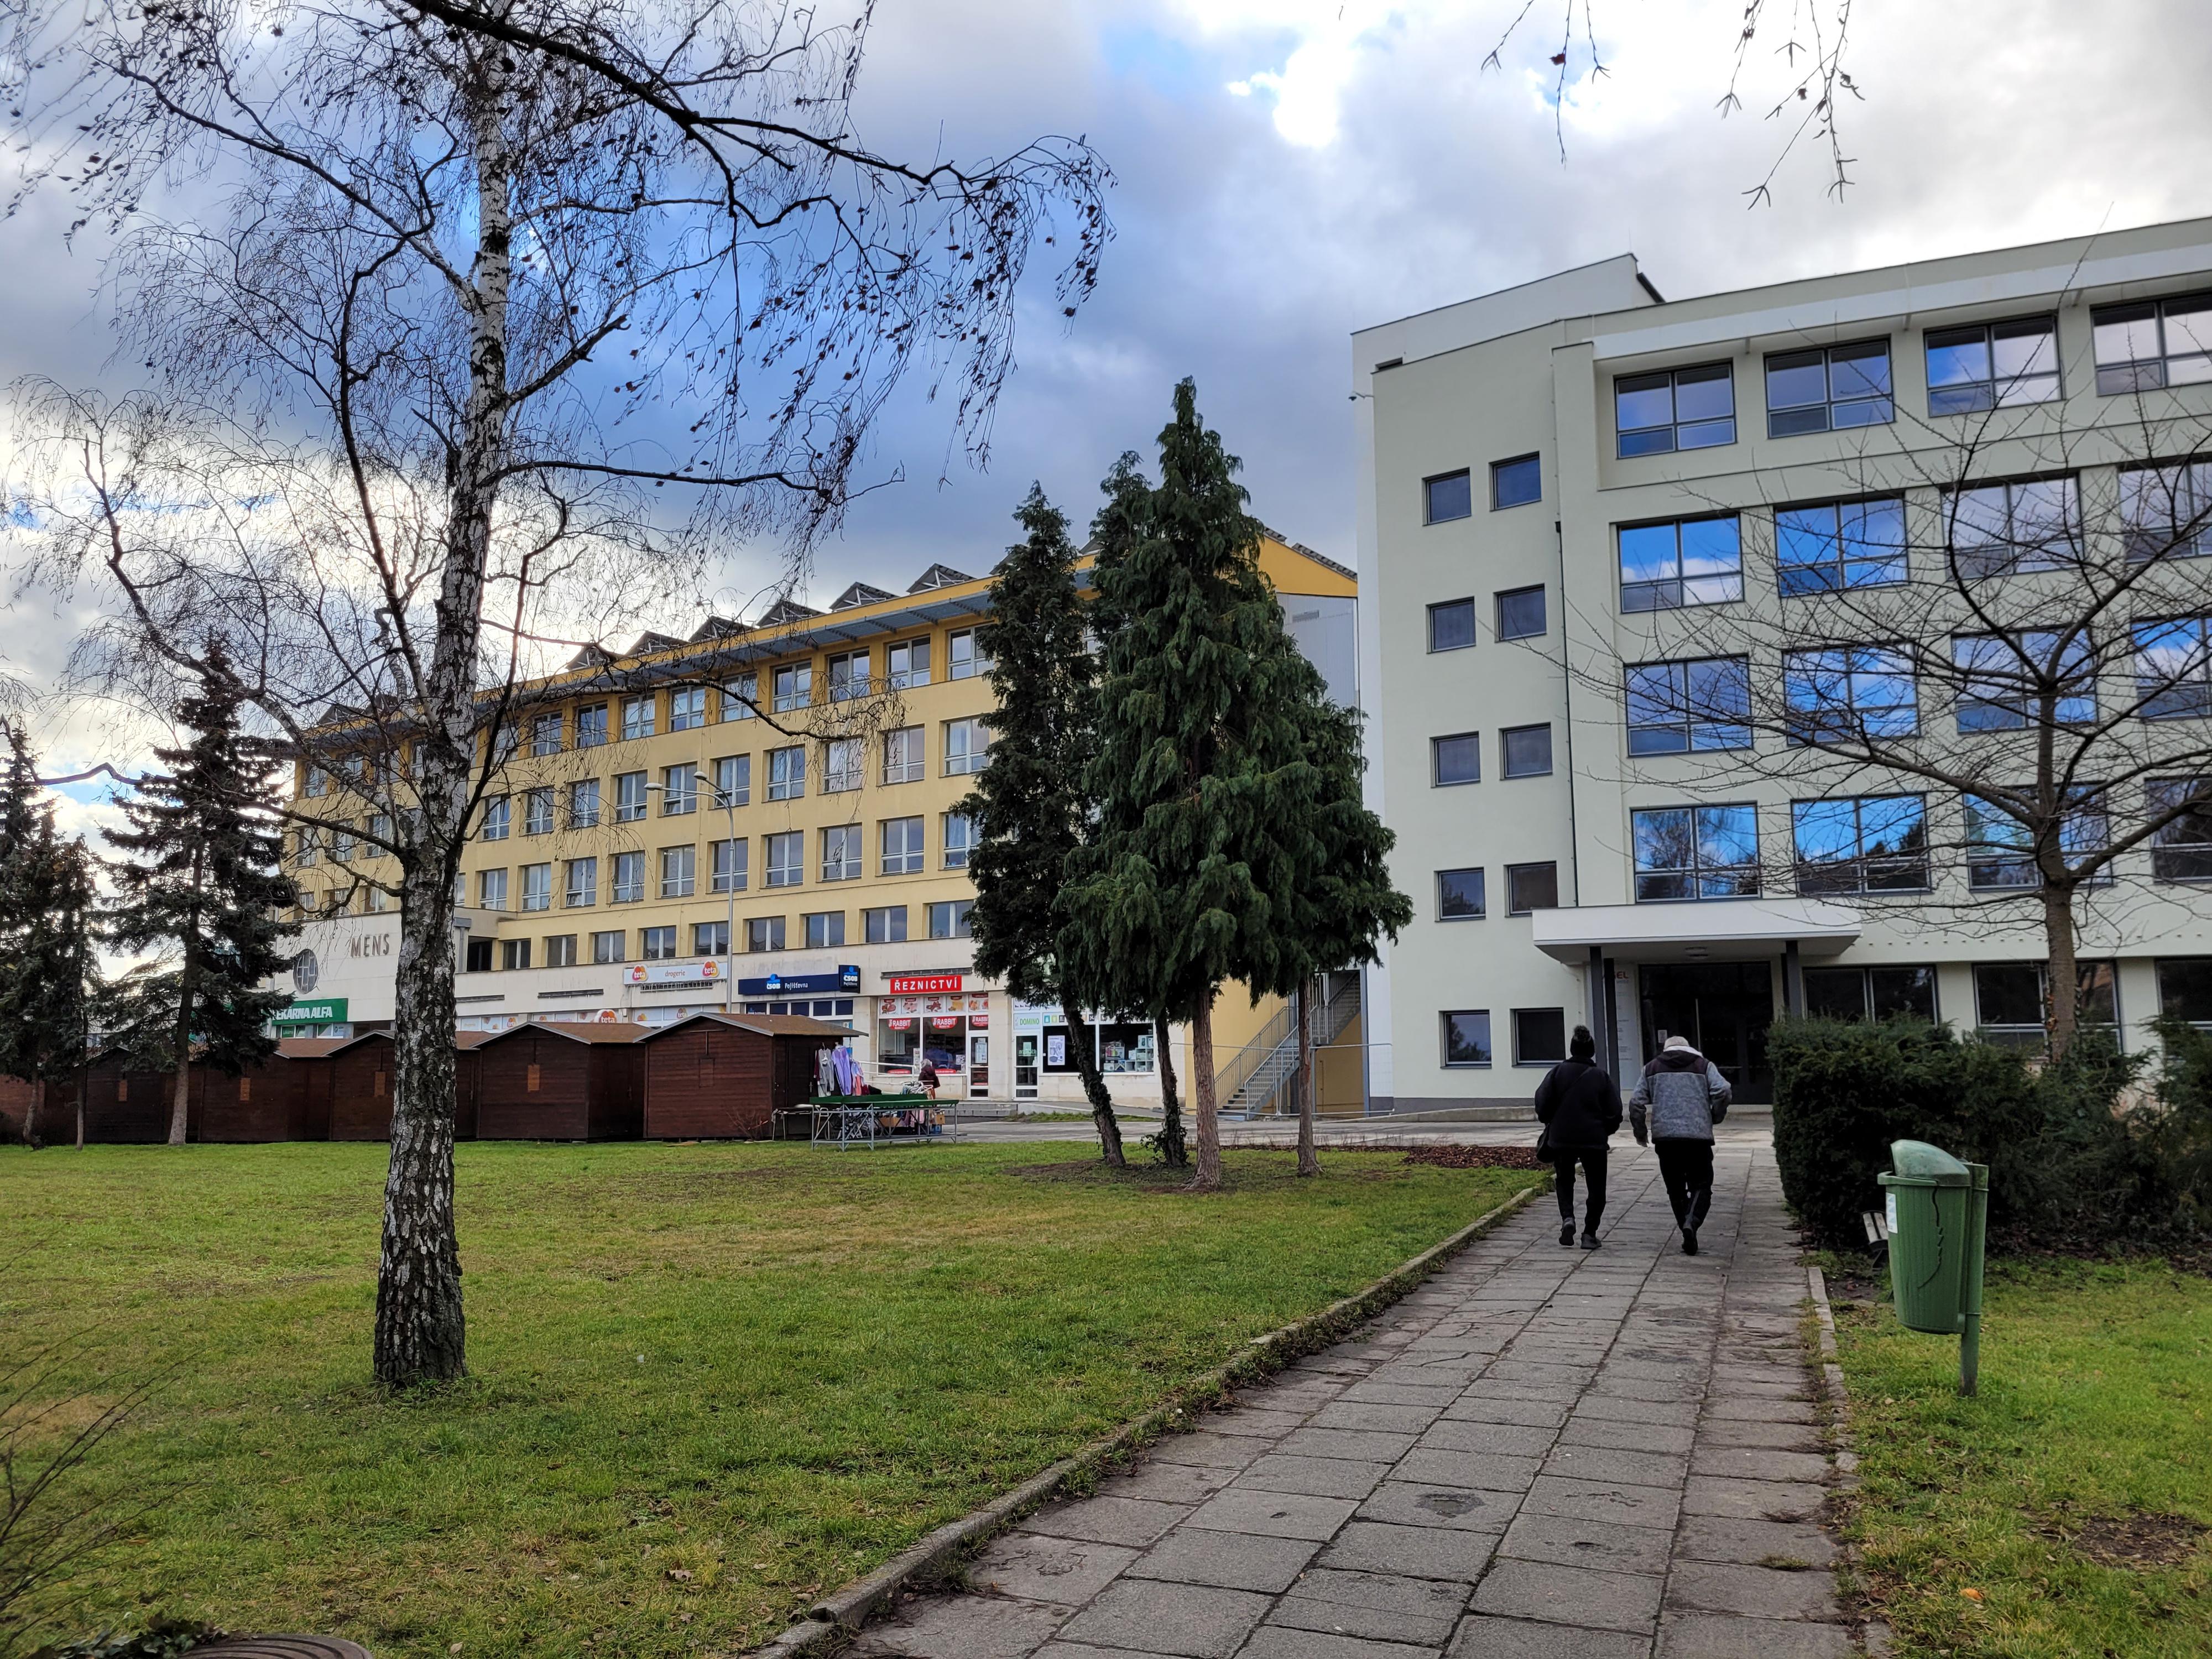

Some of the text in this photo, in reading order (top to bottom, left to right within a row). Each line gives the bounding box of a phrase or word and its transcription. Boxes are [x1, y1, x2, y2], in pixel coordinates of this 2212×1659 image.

[350, 933, 389, 958] MENS
[665, 969, 685, 978] drogerie
[784, 982, 808, 990] Pojišťovna
[894, 977, 957, 991] ŘEZNICTVÍ
[310, 1006, 333, 1019] ALFA
